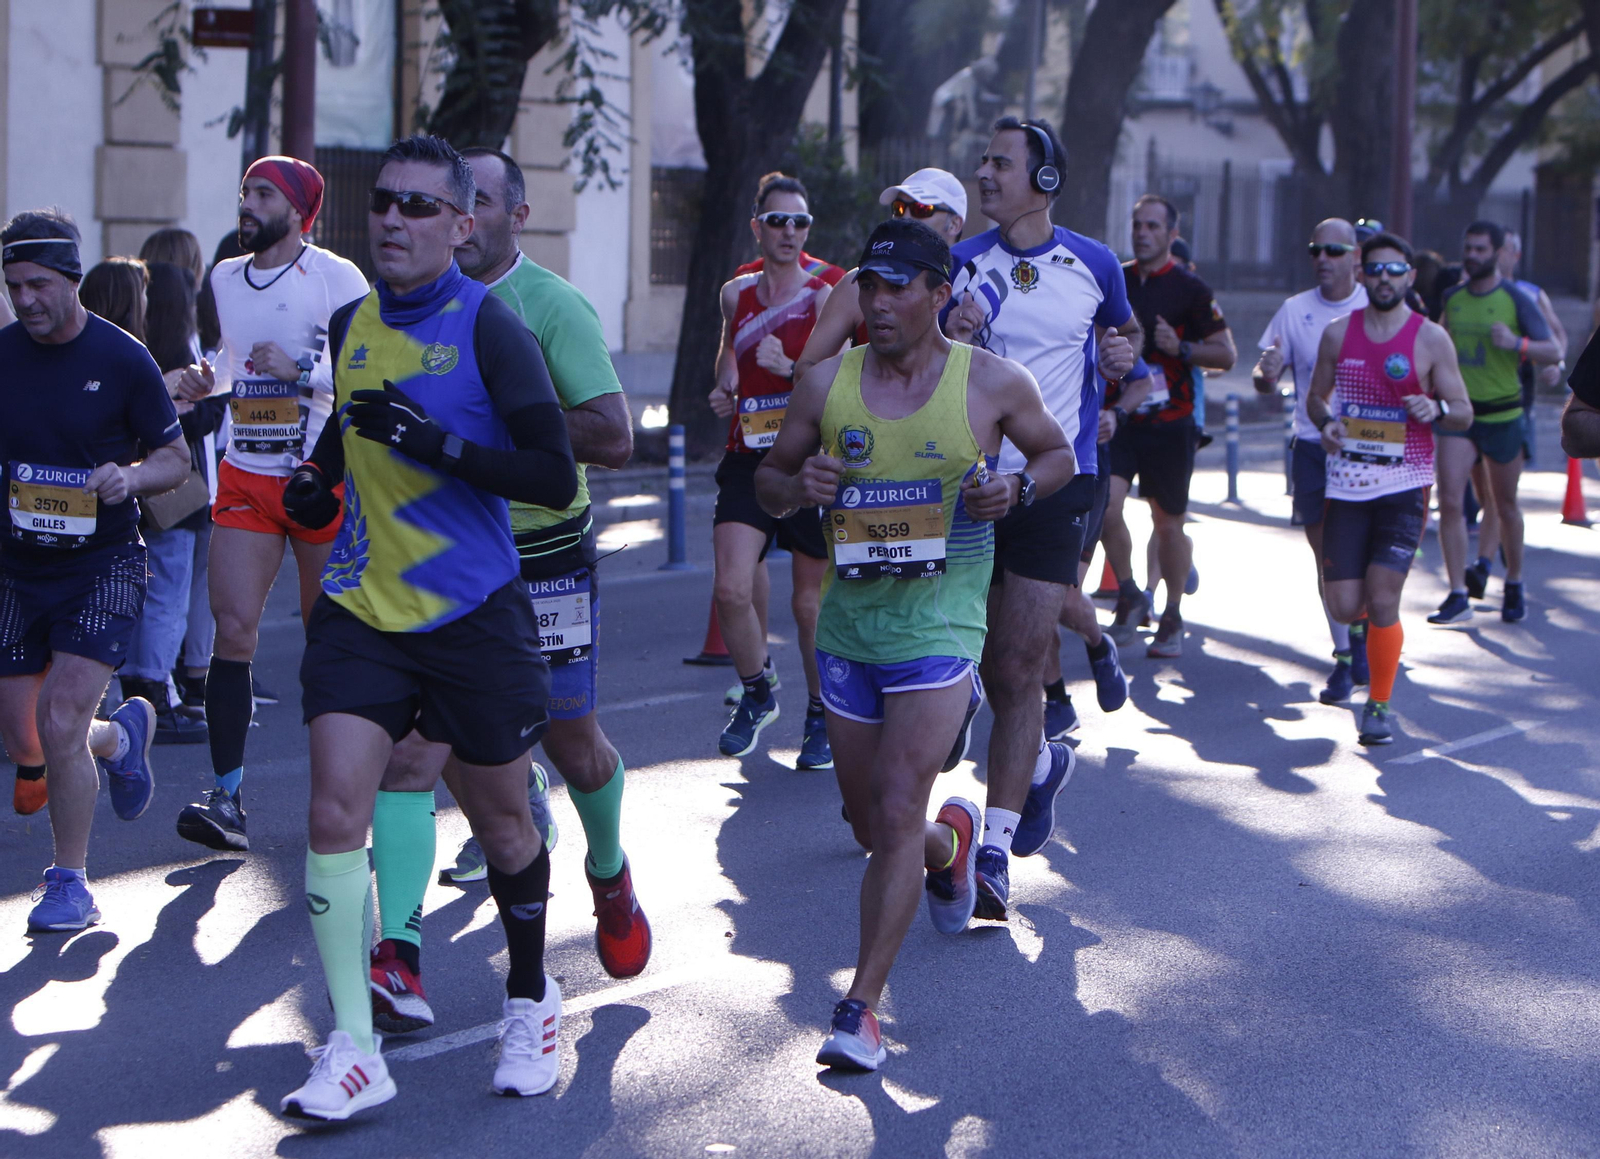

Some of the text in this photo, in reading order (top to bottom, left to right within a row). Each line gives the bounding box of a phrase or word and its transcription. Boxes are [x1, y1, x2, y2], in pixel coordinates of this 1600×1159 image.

[248, 384, 287, 395] ZURICH
[760, 396, 790, 408] ZURIC
[250, 410, 277, 421] 4443
[1361, 408, 1399, 420] ZURICH
[765, 418, 783, 429] 457
[914, 451, 947, 460] SURAL
[36, 469, 86, 484] ZURICH
[865, 486, 928, 503] ZURICH
[34, 497, 69, 513] 3570
[32, 517, 66, 530] GILLES
[867, 522, 910, 539] 5359
[868, 545, 912, 559] PEROTE
[920, 570, 942, 578] ZURICH
[528, 577, 576, 594] URICH
[535, 612, 559, 628] 87
[540, 632, 564, 648] STÍN
[568, 656, 589, 664] ZURICH
[545, 691, 587, 711] TEPONA
